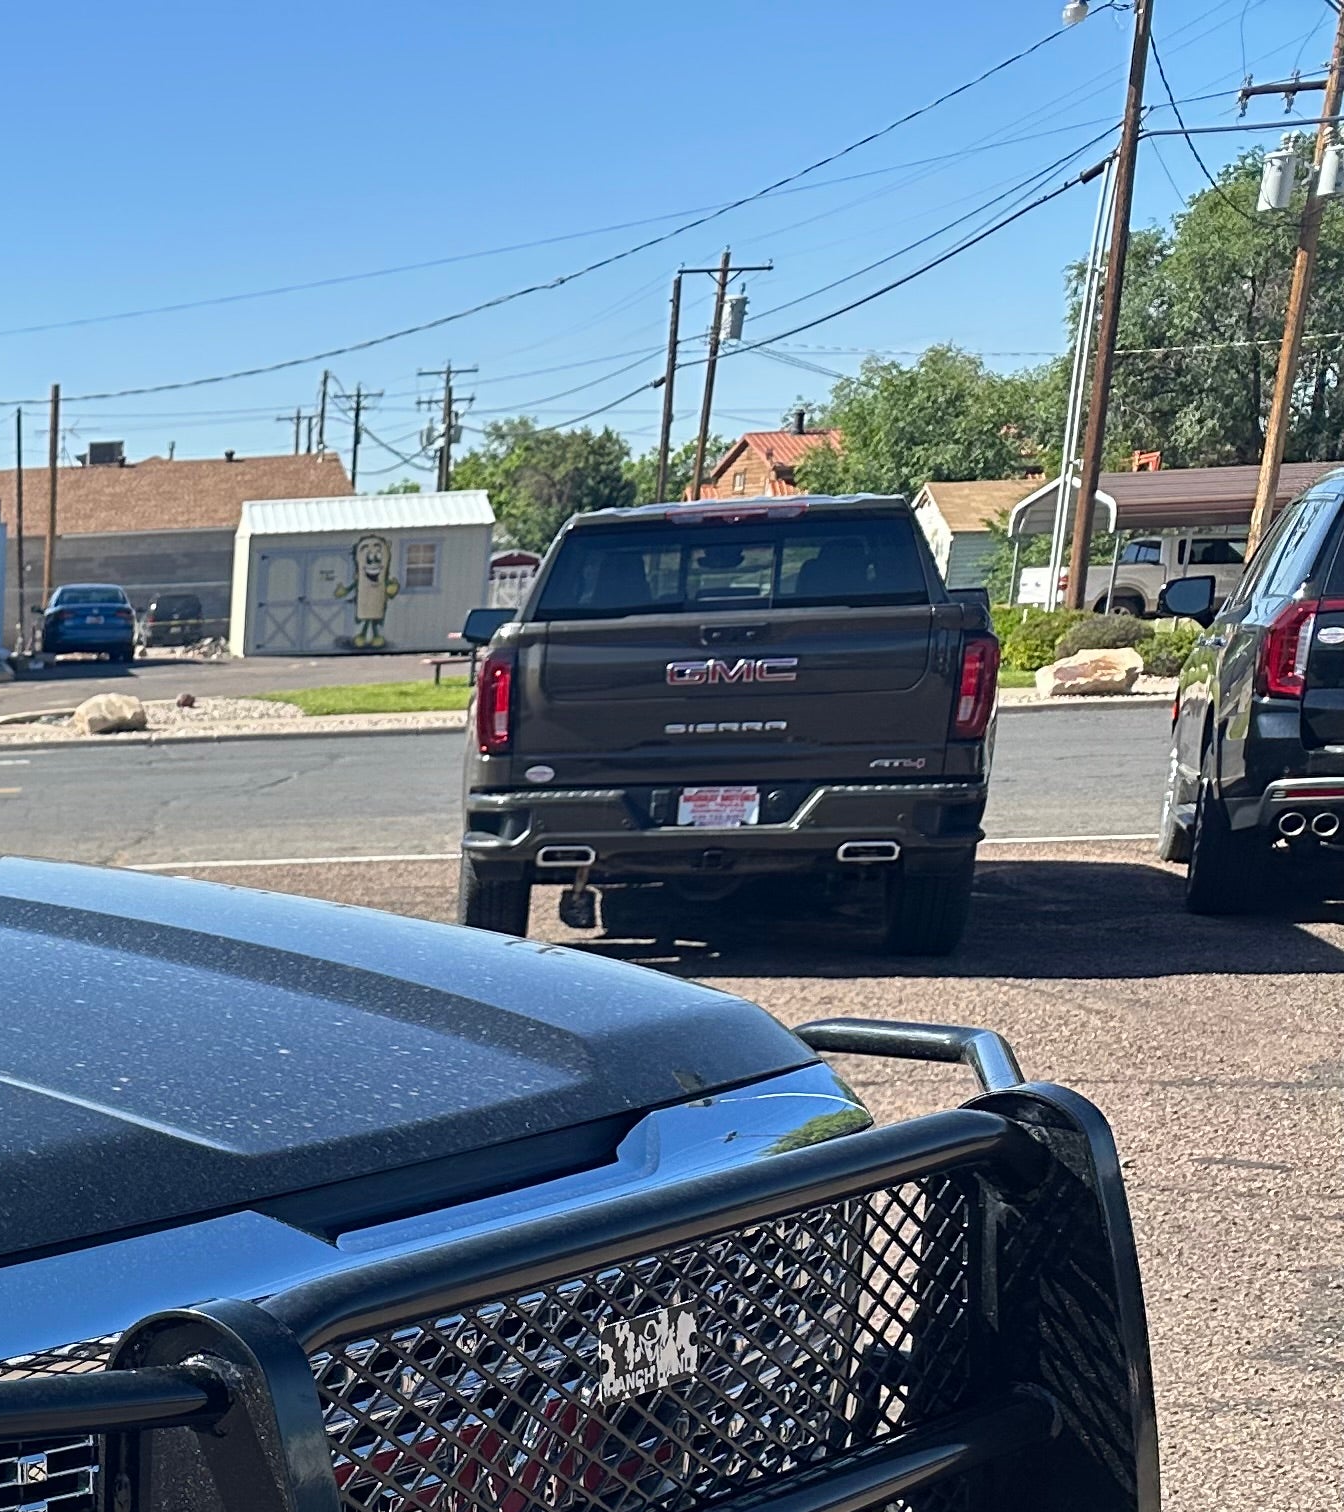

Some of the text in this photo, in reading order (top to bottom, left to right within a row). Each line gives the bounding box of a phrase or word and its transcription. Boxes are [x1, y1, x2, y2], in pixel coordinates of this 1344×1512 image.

[665, 657, 799, 686] GMC
[664, 720, 788, 735] SIERRA
[869, 757, 927, 769] AT4
